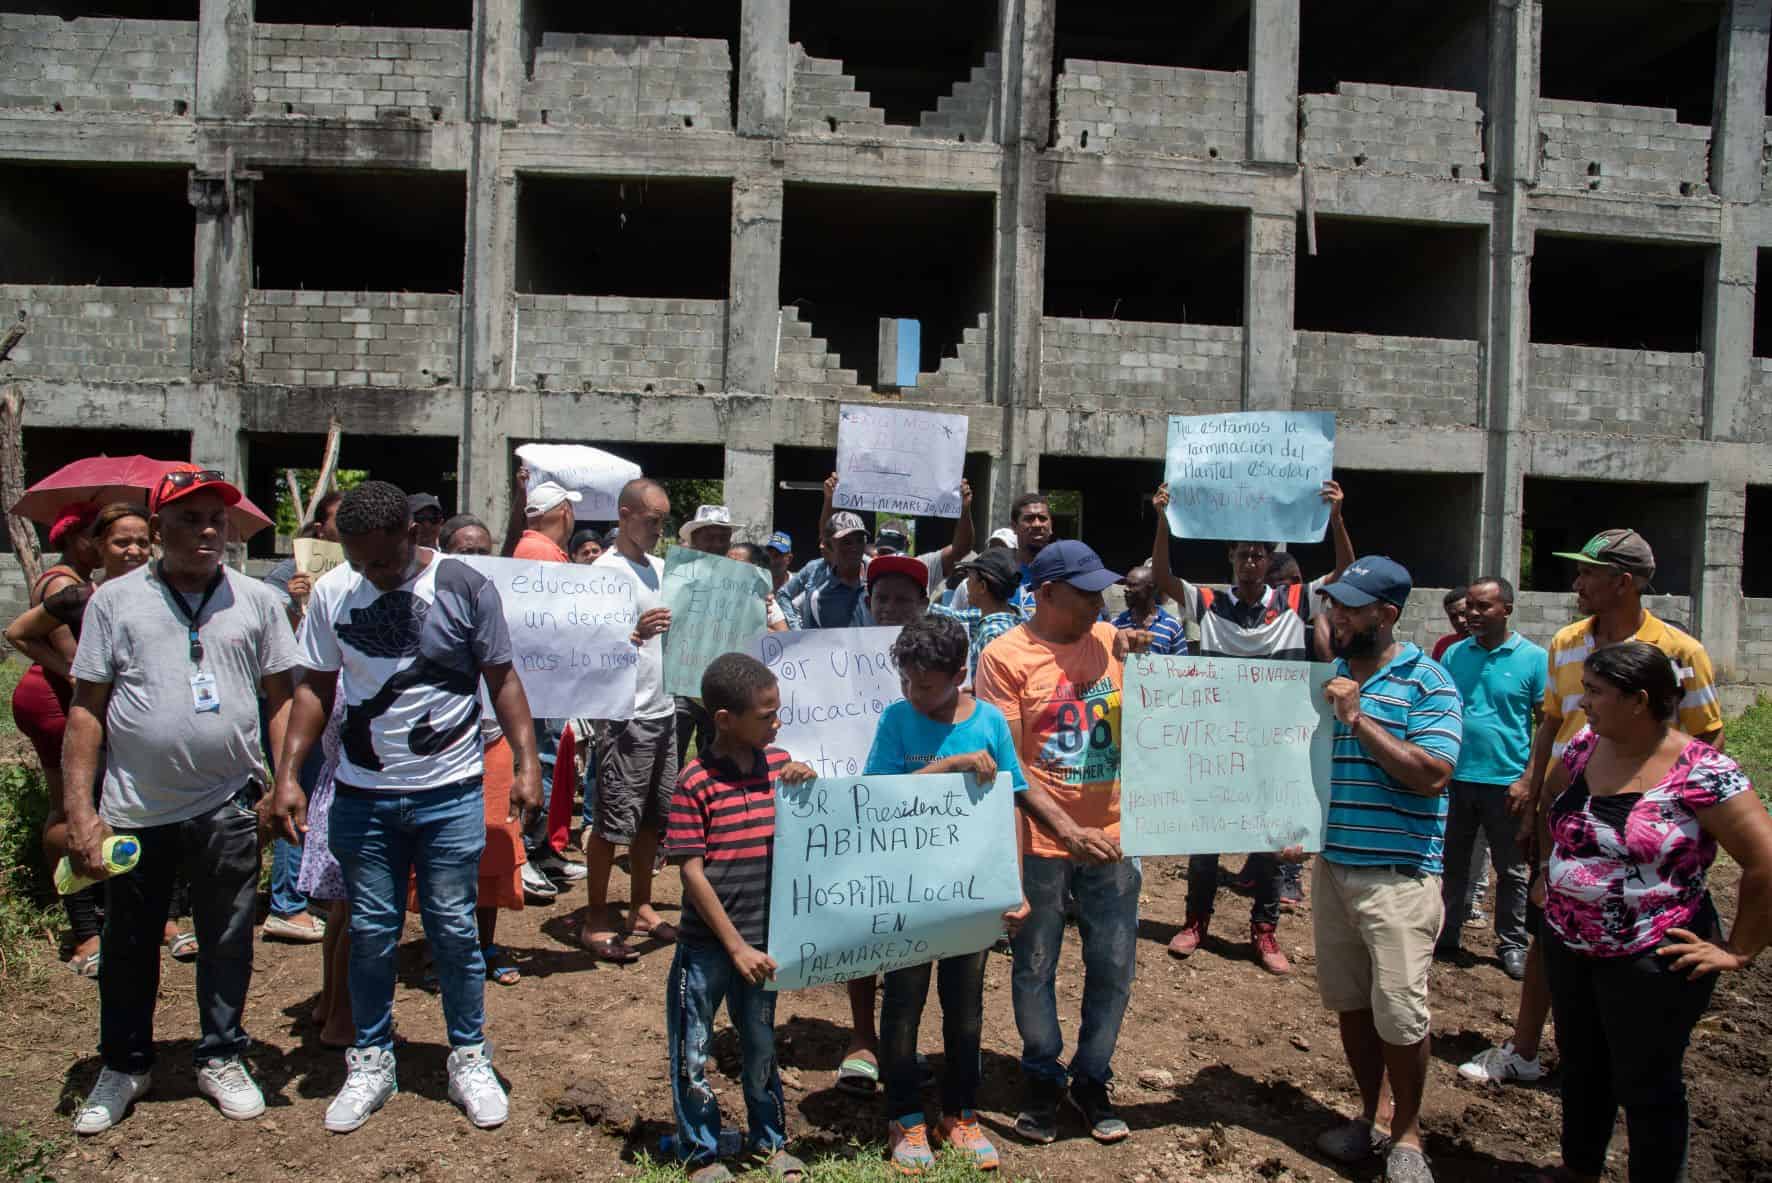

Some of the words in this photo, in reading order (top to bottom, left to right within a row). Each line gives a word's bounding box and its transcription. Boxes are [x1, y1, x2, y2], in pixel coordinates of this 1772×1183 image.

[524, 607, 557, 630] un
[779, 683, 904, 726] ducació
[1187, 751, 1246, 784] PARA
[849, 783, 970, 825] Presidente
[907, 873, 985, 904] LOCAL
[871, 912, 907, 935] EN
[799, 940, 929, 979] PALMAREJO
